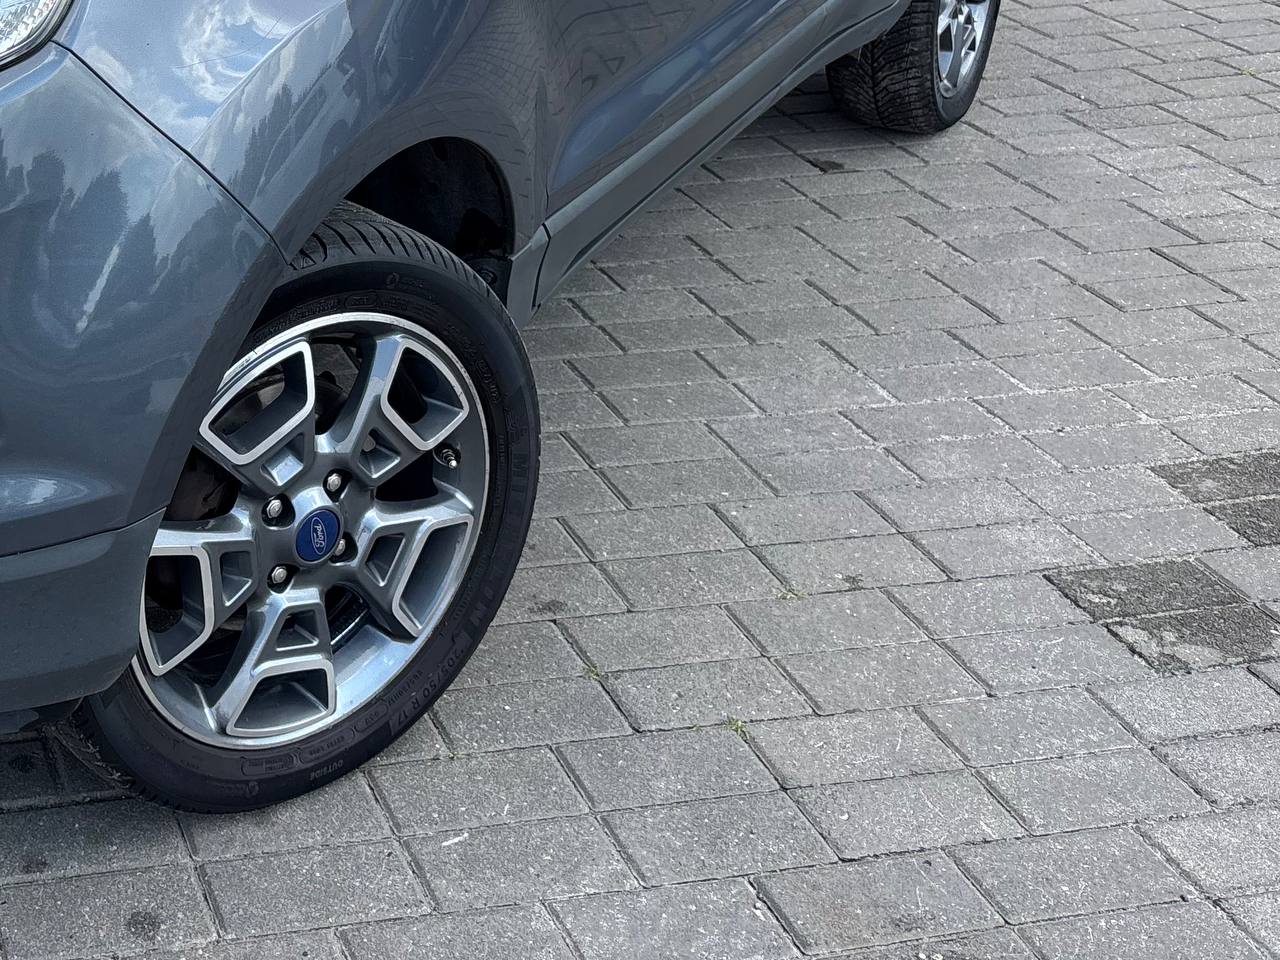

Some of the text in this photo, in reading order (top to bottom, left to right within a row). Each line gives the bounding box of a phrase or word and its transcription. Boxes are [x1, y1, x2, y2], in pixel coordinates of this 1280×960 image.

[313, 523, 326, 548] Ford
[411, 698, 421, 710] R
[398, 709, 409, 726] 17
[309, 759, 345, 781] OUTSIDE
